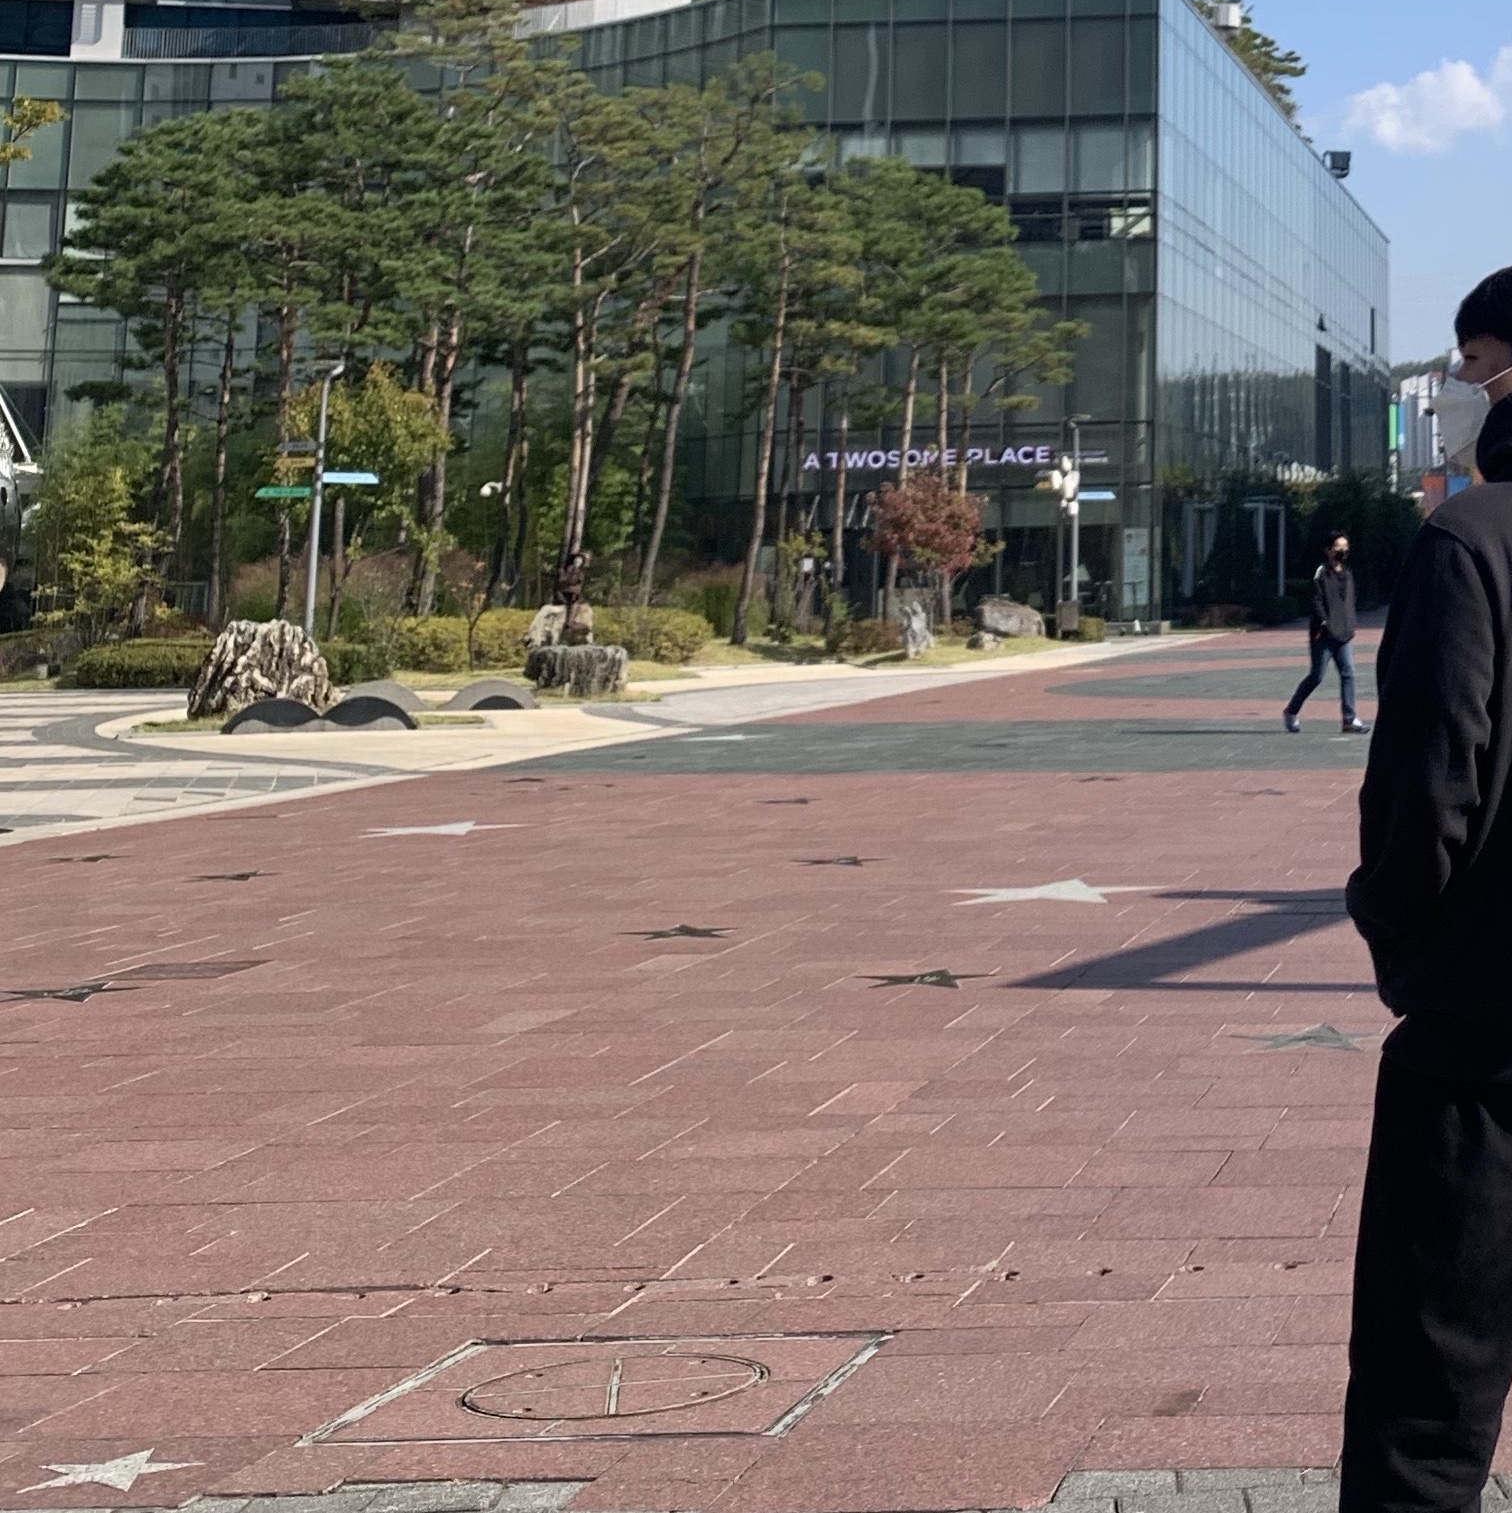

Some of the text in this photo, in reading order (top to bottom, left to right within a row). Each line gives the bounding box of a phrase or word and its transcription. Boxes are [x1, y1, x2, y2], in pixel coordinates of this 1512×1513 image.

[802, 451, 821, 471] A
[825, 447, 957, 470] TWOSOME
[965, 444, 1052, 467] PLACE
